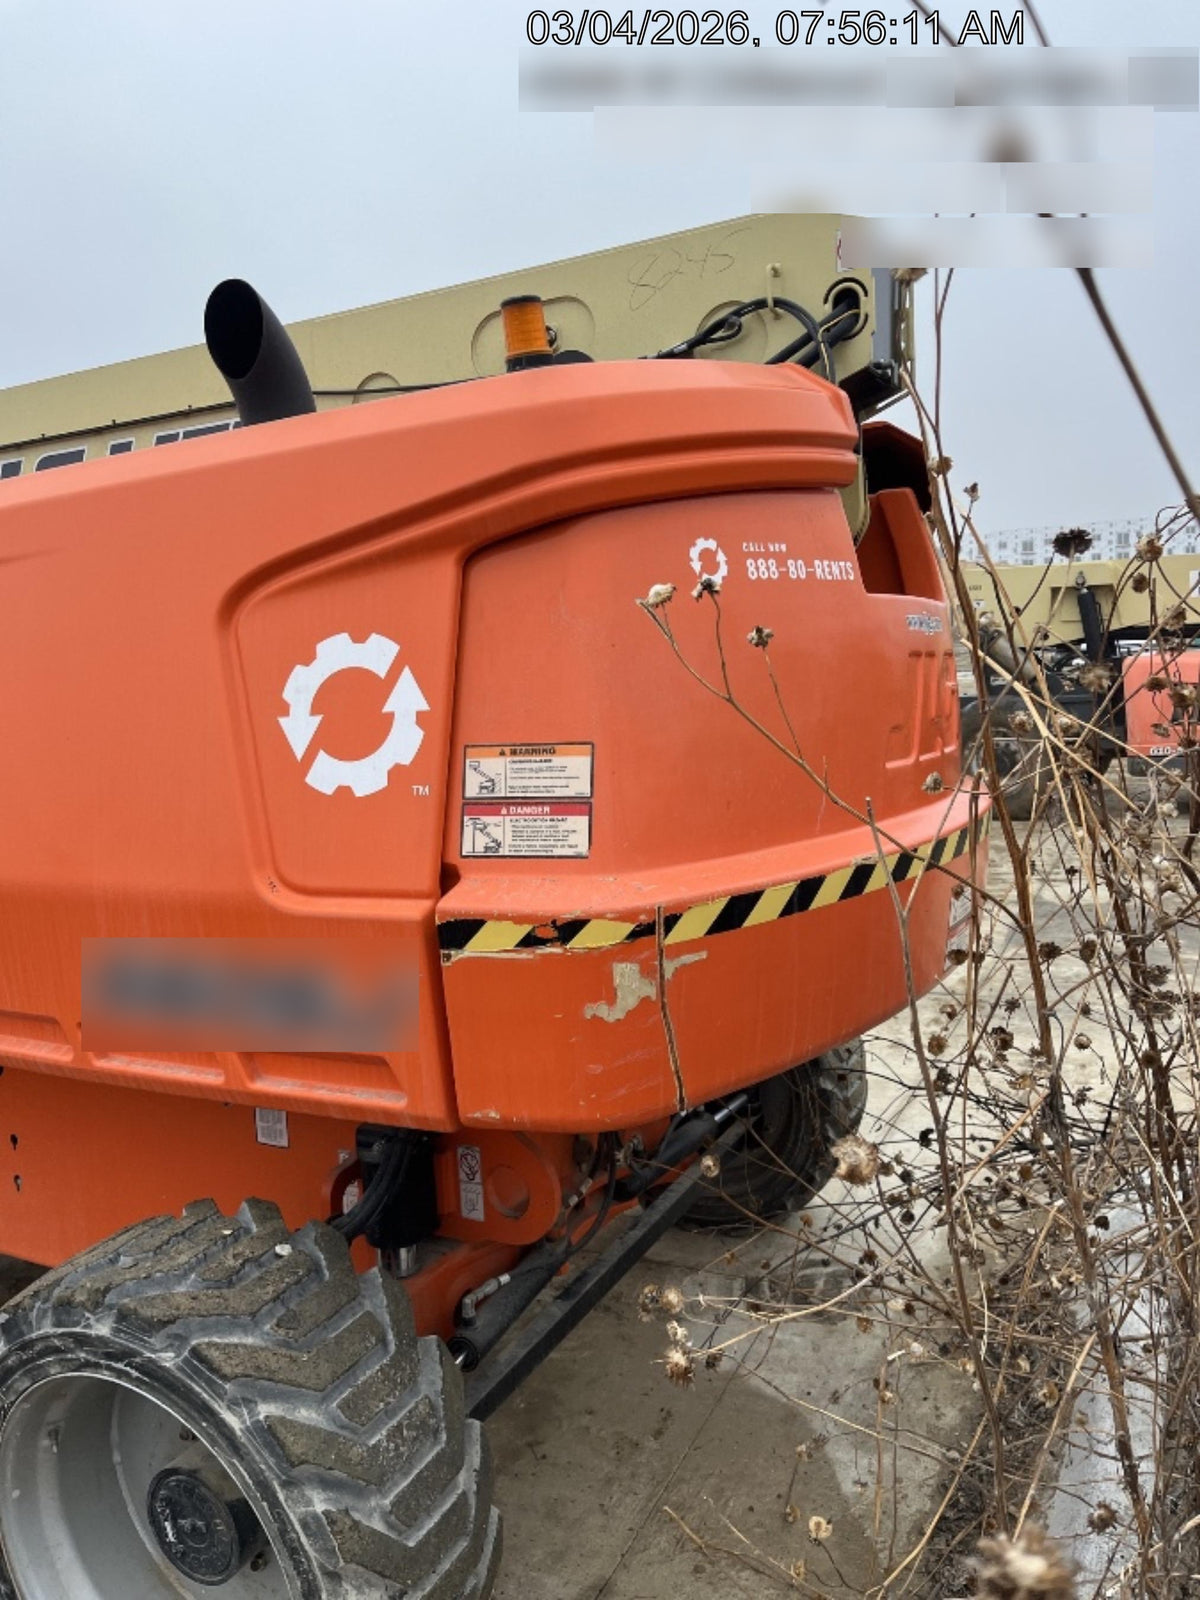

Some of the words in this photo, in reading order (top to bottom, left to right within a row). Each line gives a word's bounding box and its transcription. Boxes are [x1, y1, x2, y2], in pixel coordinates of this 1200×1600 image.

[742, 542, 765, 552] CALL
[746, 558, 855, 580] 888-80-RENTS
[509, 747, 557, 756] WARNING
[411, 785, 430, 796] TM
[509, 806, 551, 815] DANGER
